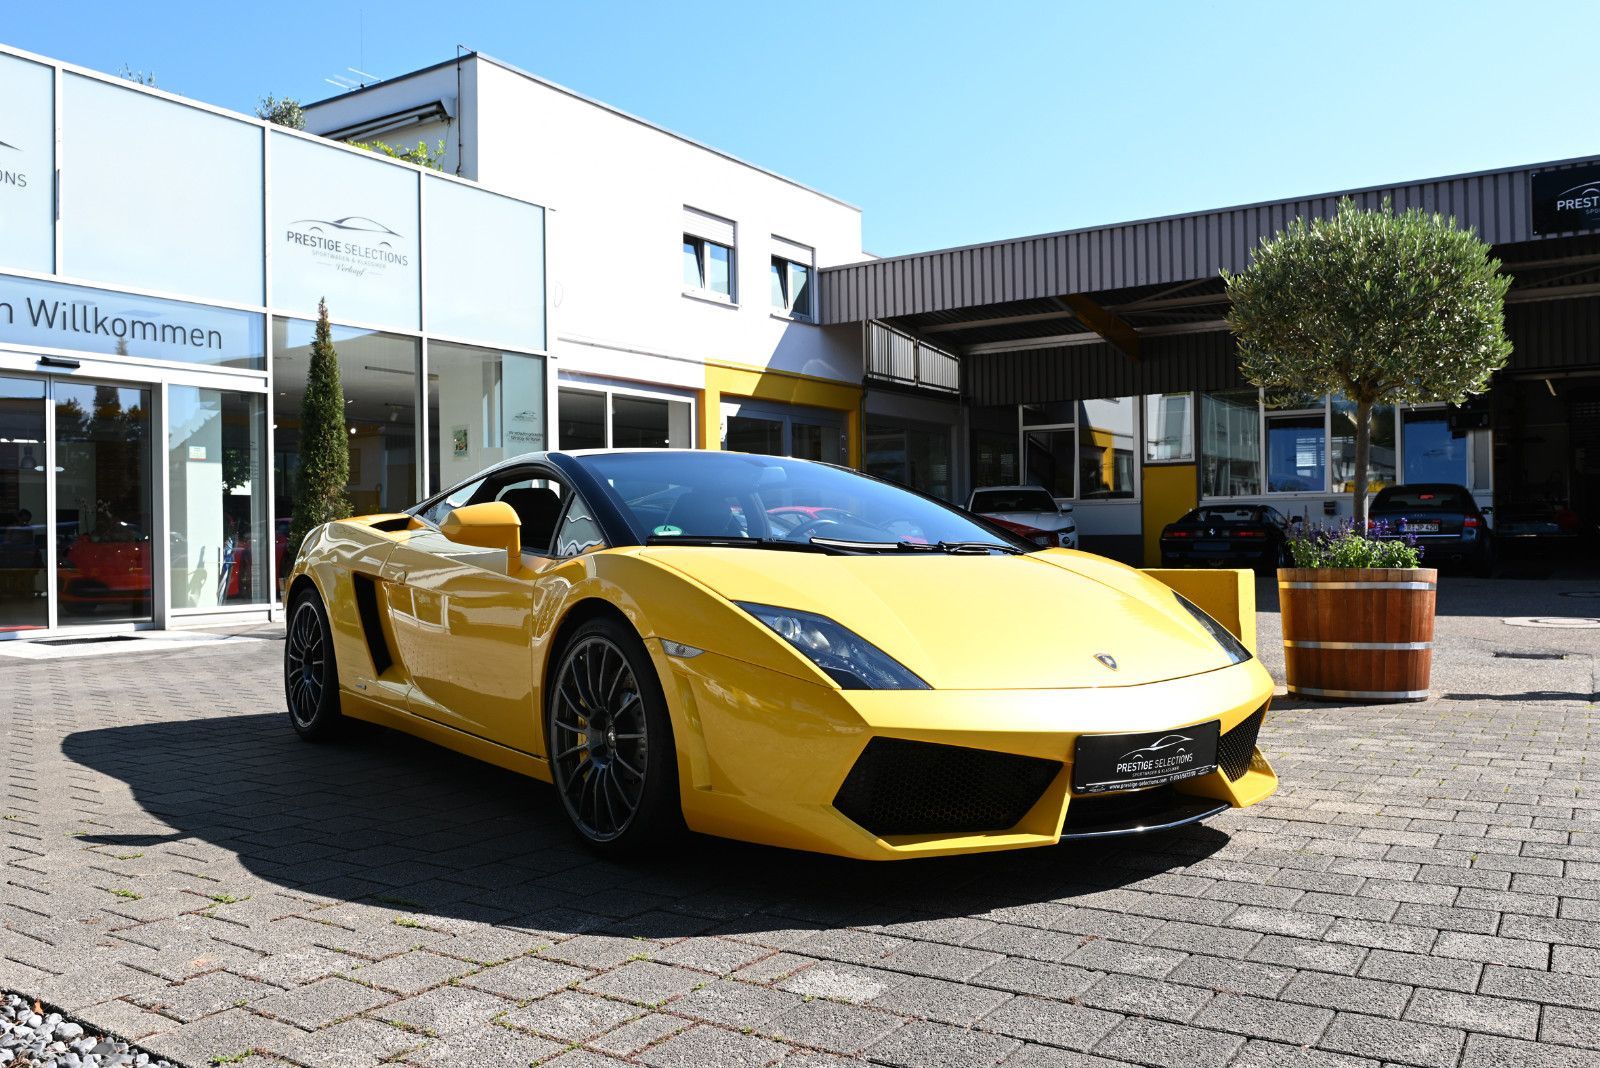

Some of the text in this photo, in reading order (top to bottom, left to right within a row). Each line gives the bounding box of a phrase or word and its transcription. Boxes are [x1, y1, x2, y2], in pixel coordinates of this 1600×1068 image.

[0, 169, 27, 188] NS
[1557, 196, 1600, 211] PREST
[286, 231, 408, 266] PRESTIGE SELECTIONS
[26, 297, 222, 350] Willkommen
[1116, 752, 1193, 773] PRESTIGE SELECTIONS
